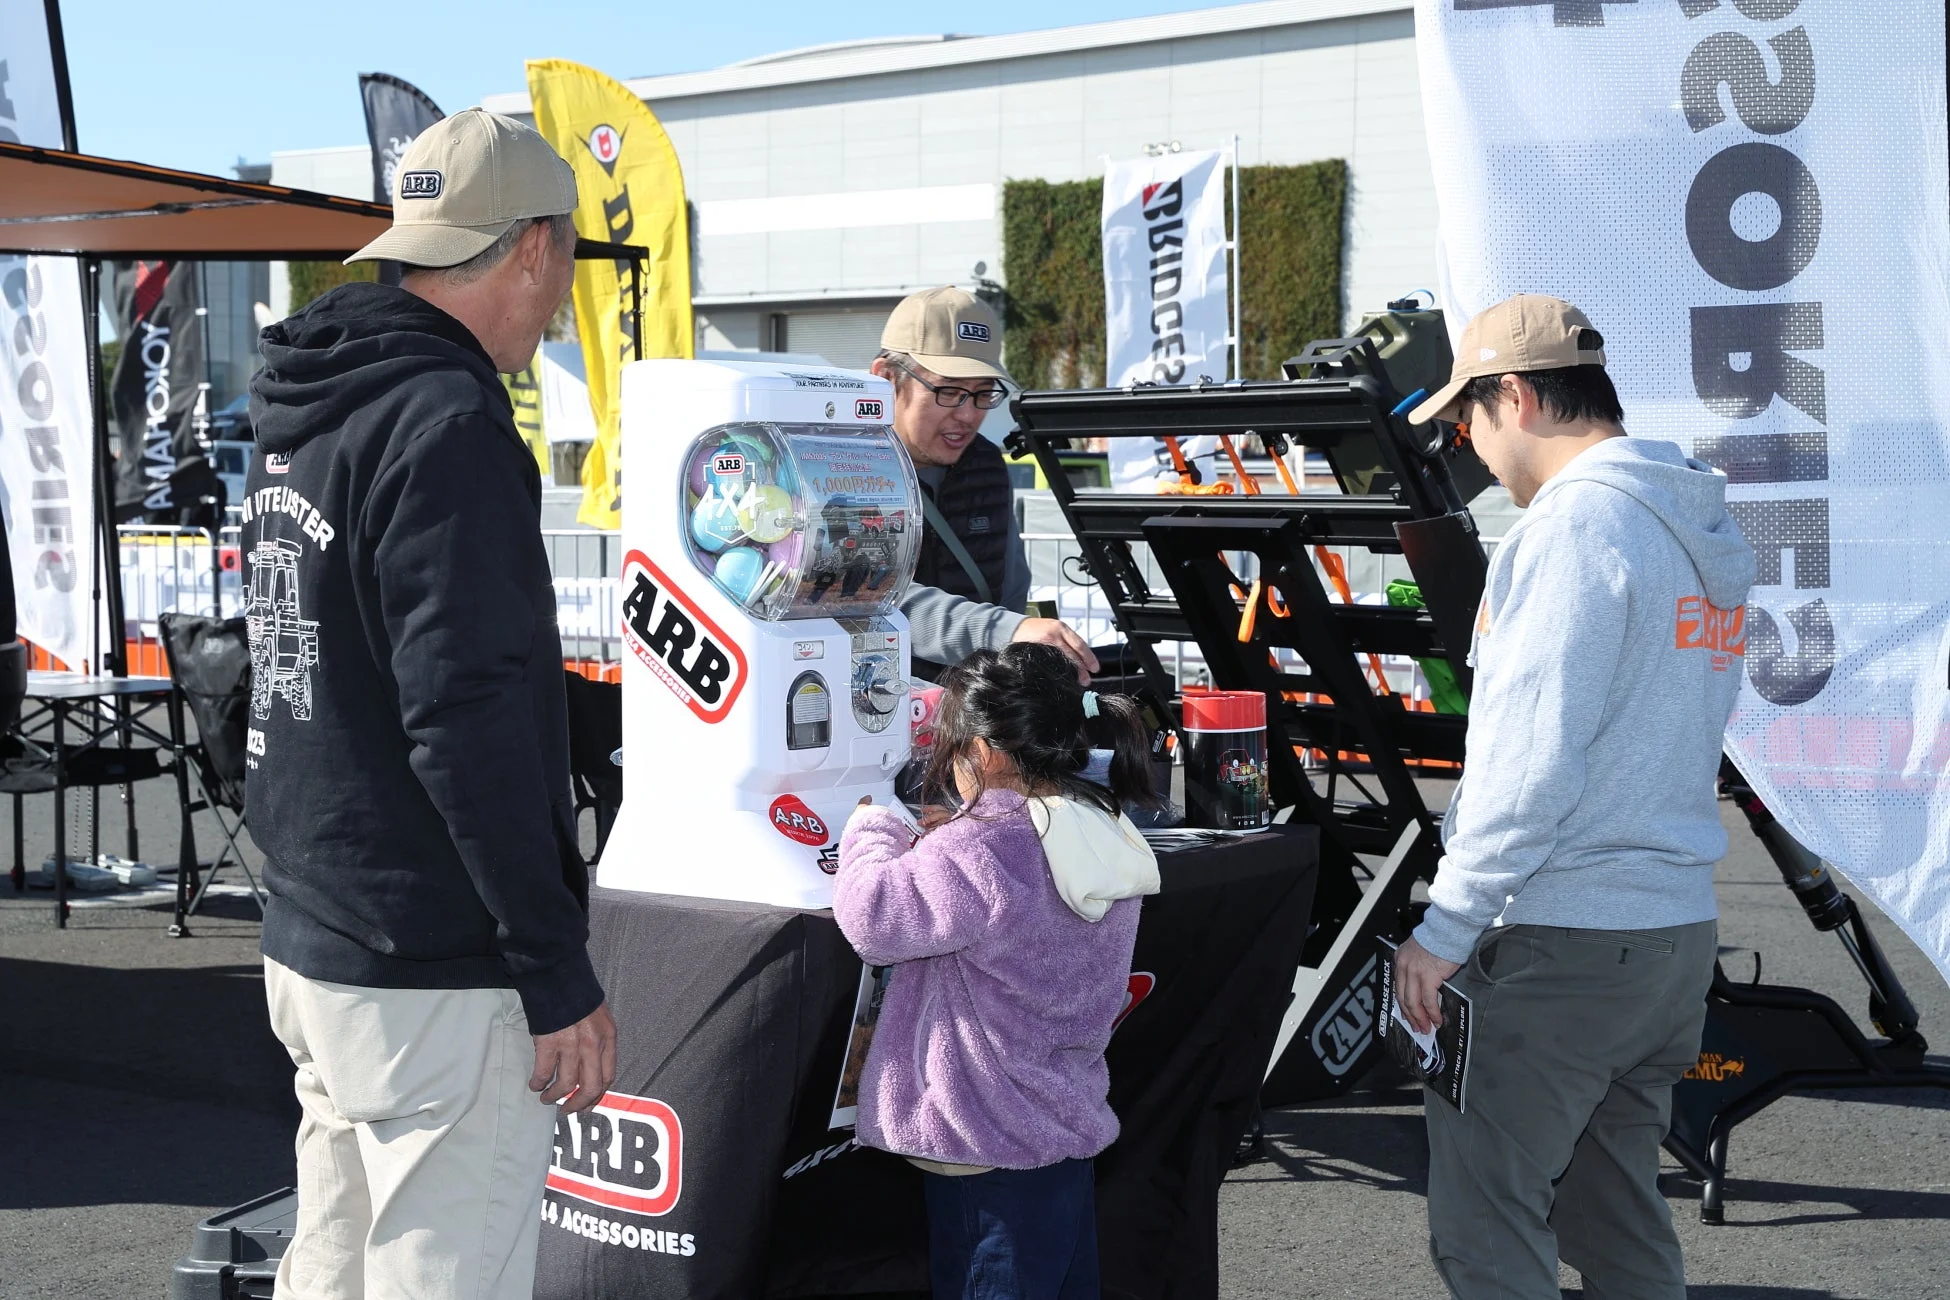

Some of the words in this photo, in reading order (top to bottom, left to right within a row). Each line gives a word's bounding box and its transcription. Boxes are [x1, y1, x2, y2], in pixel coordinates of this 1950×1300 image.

[404, 175, 437, 194] ARB
[962, 325, 989, 339] ARB
[795, 380, 806, 388] YOUR
[858, 402, 881, 416] ARB
[717, 459, 741, 471] ARB
[622, 570, 731, 705] ARB
[638, 649, 692, 704] ACCESSORIES
[775, 807, 824, 835] ARB
[1383, 959, 1391, 986] RACK
[1381, 985, 1390, 1011] BASE
[1325, 970, 1377, 1062] AR
[1700, 1052, 1723, 1063] MAN
[552, 1109, 662, 1191] ARB
[560, 1206, 697, 1257] ACCESSORIES
